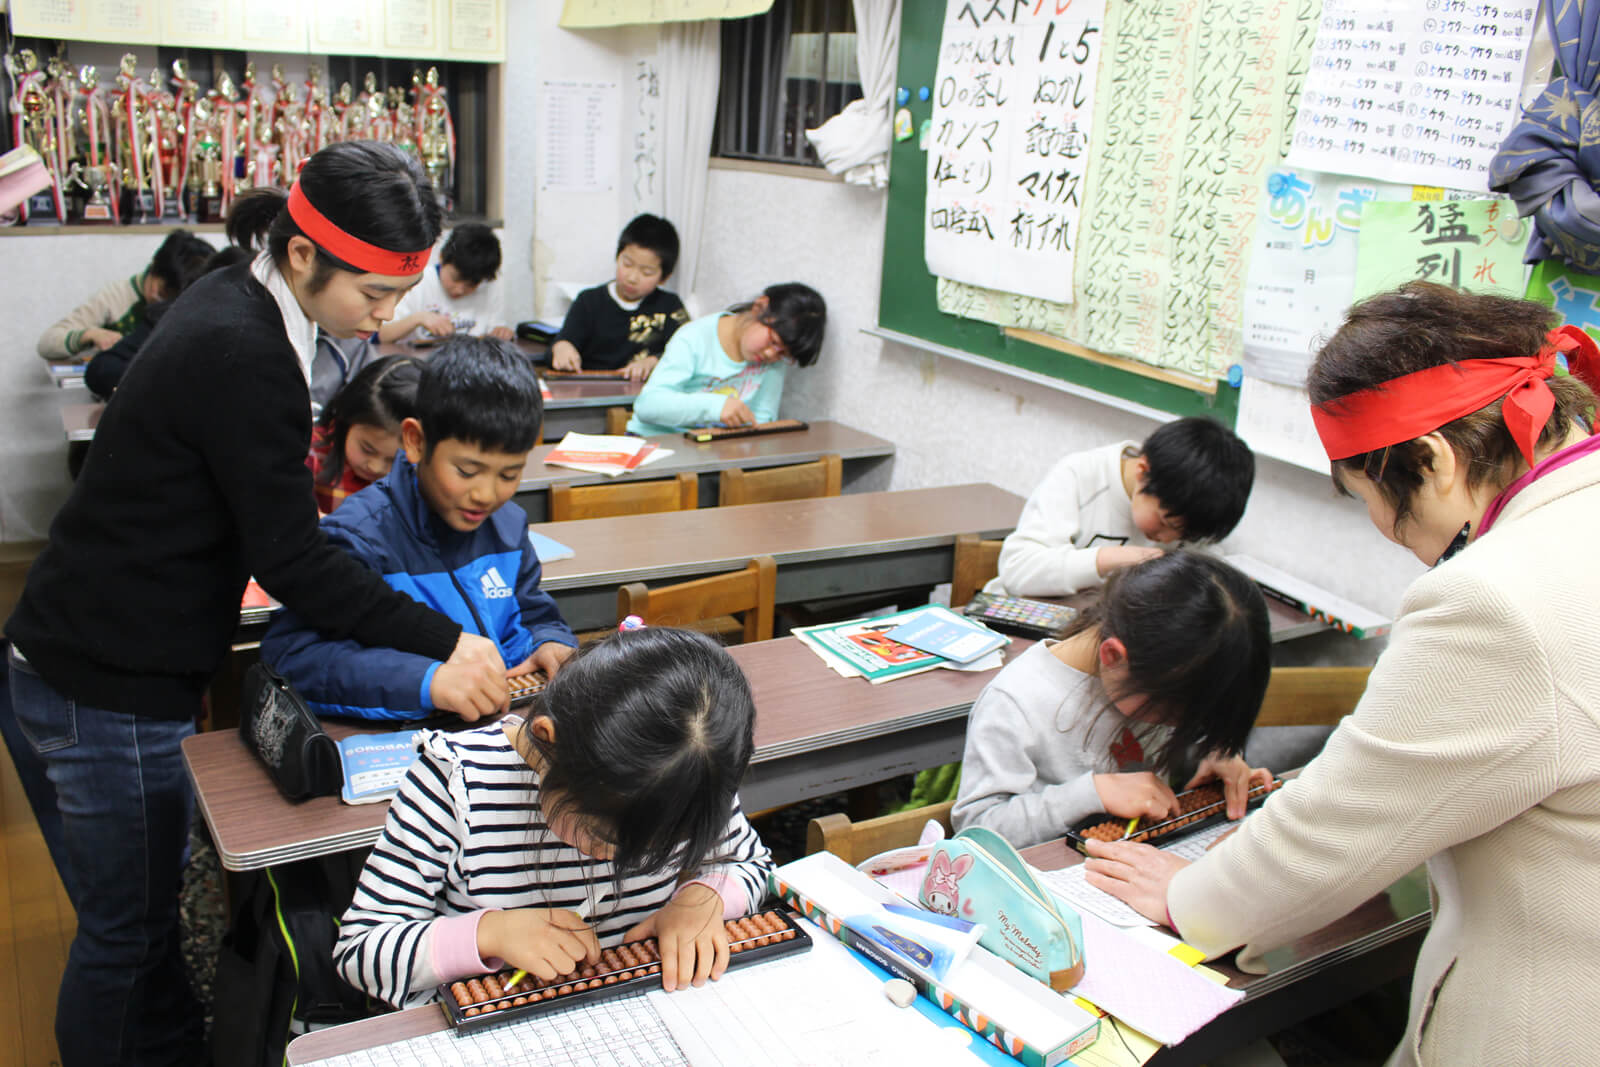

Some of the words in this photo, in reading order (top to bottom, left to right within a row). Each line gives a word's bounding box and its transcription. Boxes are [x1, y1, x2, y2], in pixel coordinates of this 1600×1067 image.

[1033, 72, 1086, 109] ぬかし
[937, 120, 999, 152] カンマ
[1018, 168, 1080, 207] マイナス
[998, 910, 1010, 931] My
[1011, 923, 1041, 958] Melody
